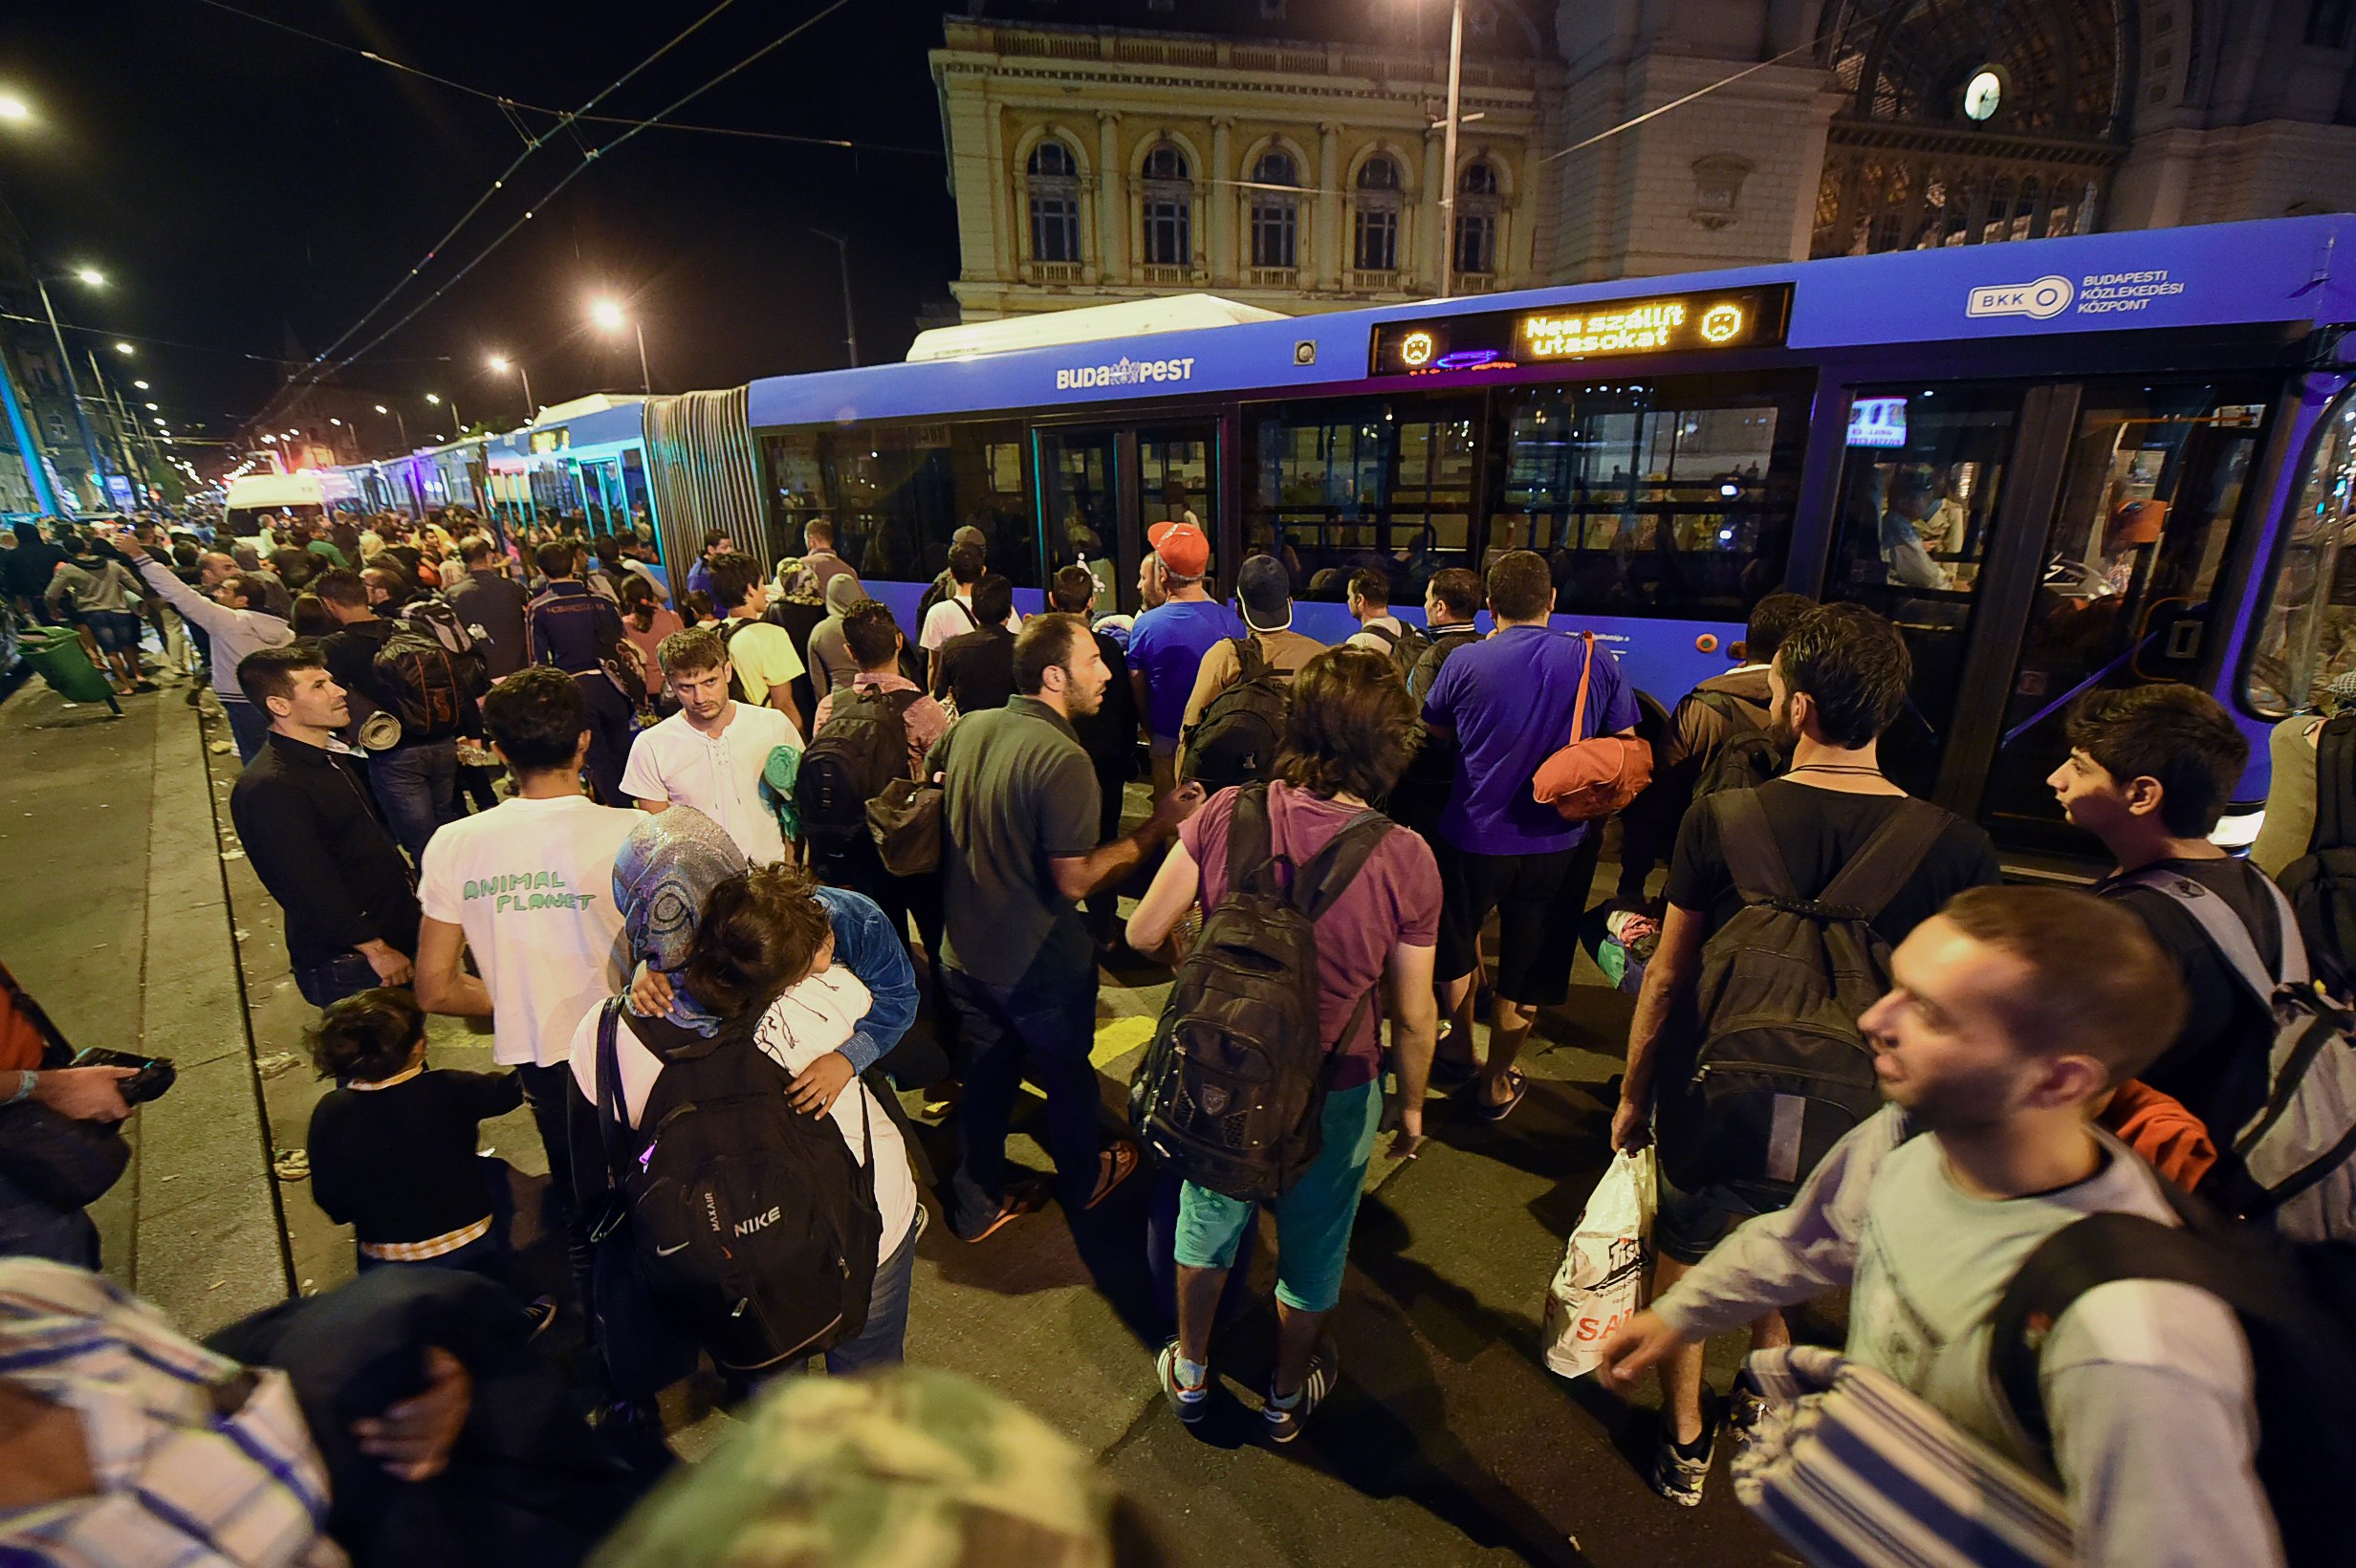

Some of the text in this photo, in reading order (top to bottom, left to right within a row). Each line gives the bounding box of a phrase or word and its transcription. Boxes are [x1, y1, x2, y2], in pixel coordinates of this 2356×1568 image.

[2083, 270, 2169, 287] BUDAPESTI
[1981, 293, 2025, 308] BKK
[2079, 283, 2185, 301] KÖZLEKEDÉSI
[2077, 298, 2151, 315] KÖZPONT
[1527, 318, 1582, 338] Nem
[1533, 326, 1669, 355] utasokat
[464, 871, 566, 900] ANIMAL
[496, 893, 598, 913] PLANET
[733, 1206, 781, 1238] NIKE
